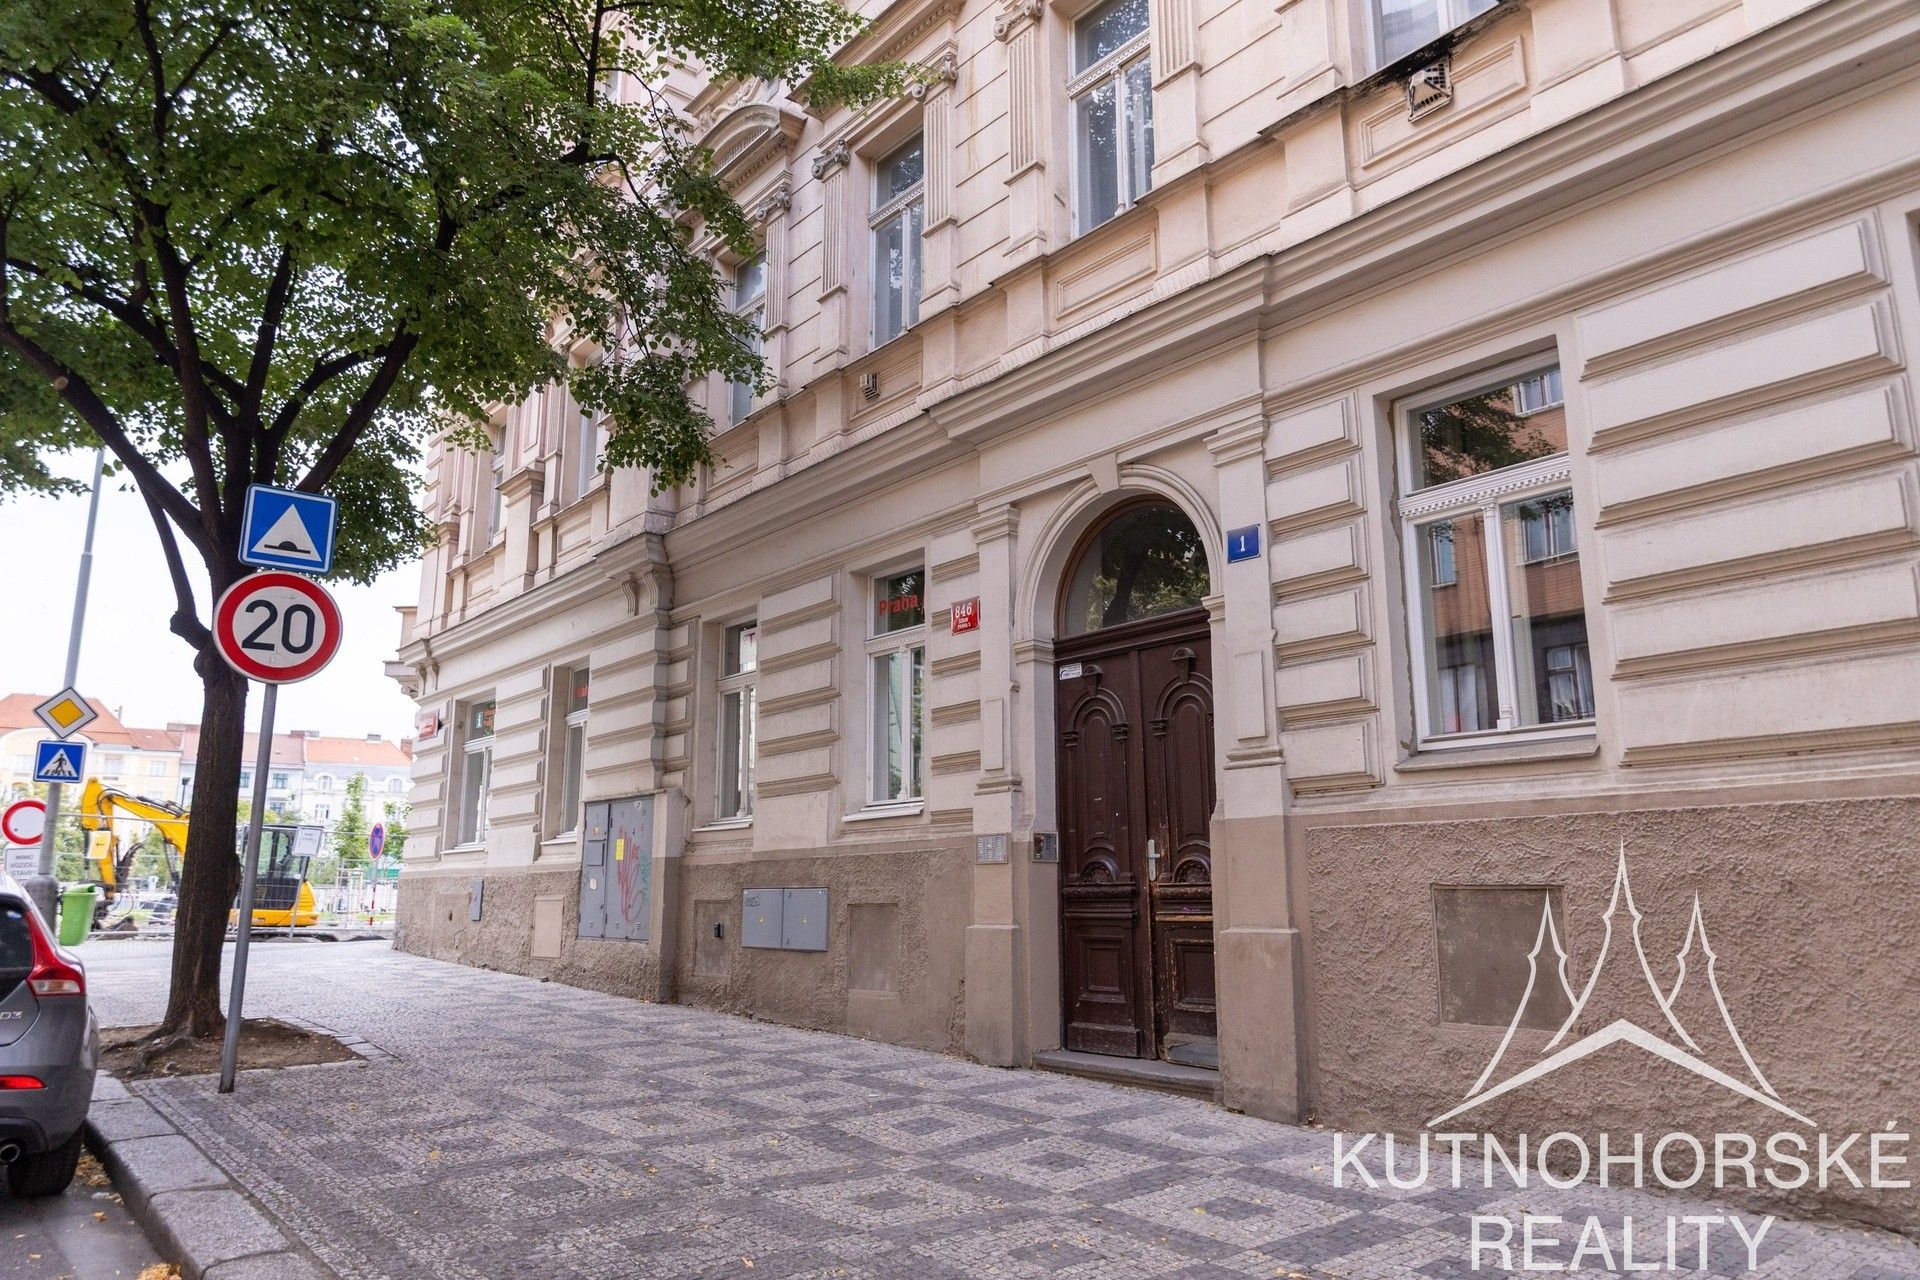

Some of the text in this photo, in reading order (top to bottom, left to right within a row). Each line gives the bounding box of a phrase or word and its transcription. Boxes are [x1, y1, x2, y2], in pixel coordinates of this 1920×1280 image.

[1240, 535, 1246, 552] 1
[955, 603, 972, 618] 846
[241, 599, 316, 655] 20
